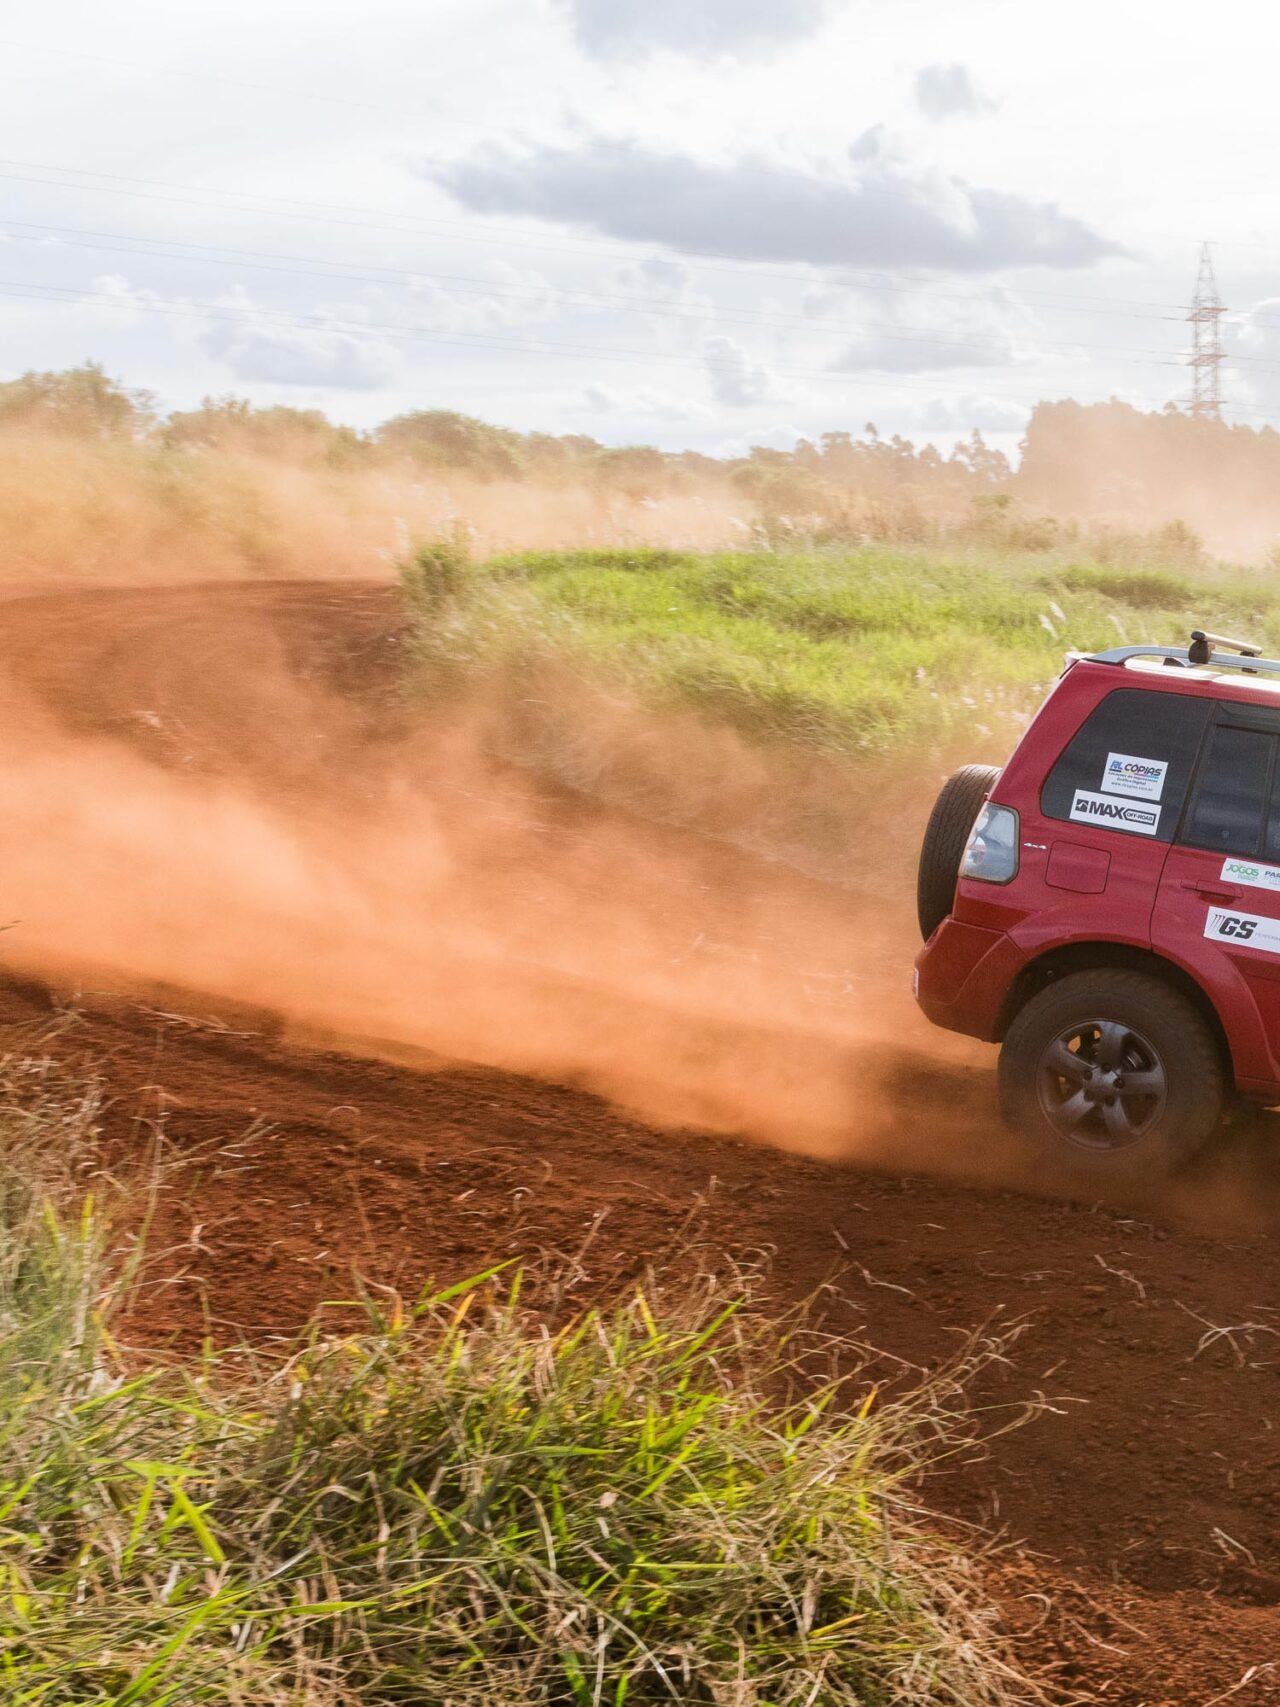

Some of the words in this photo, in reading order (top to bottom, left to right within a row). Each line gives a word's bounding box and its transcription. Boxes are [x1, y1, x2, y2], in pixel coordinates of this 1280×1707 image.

[1088, 801, 1125, 820] MAX
[1127, 812, 1153, 821] OFF-ROAD
[1226, 863, 1259, 877] JOGOS
[1218, 916, 1258, 940] GS
